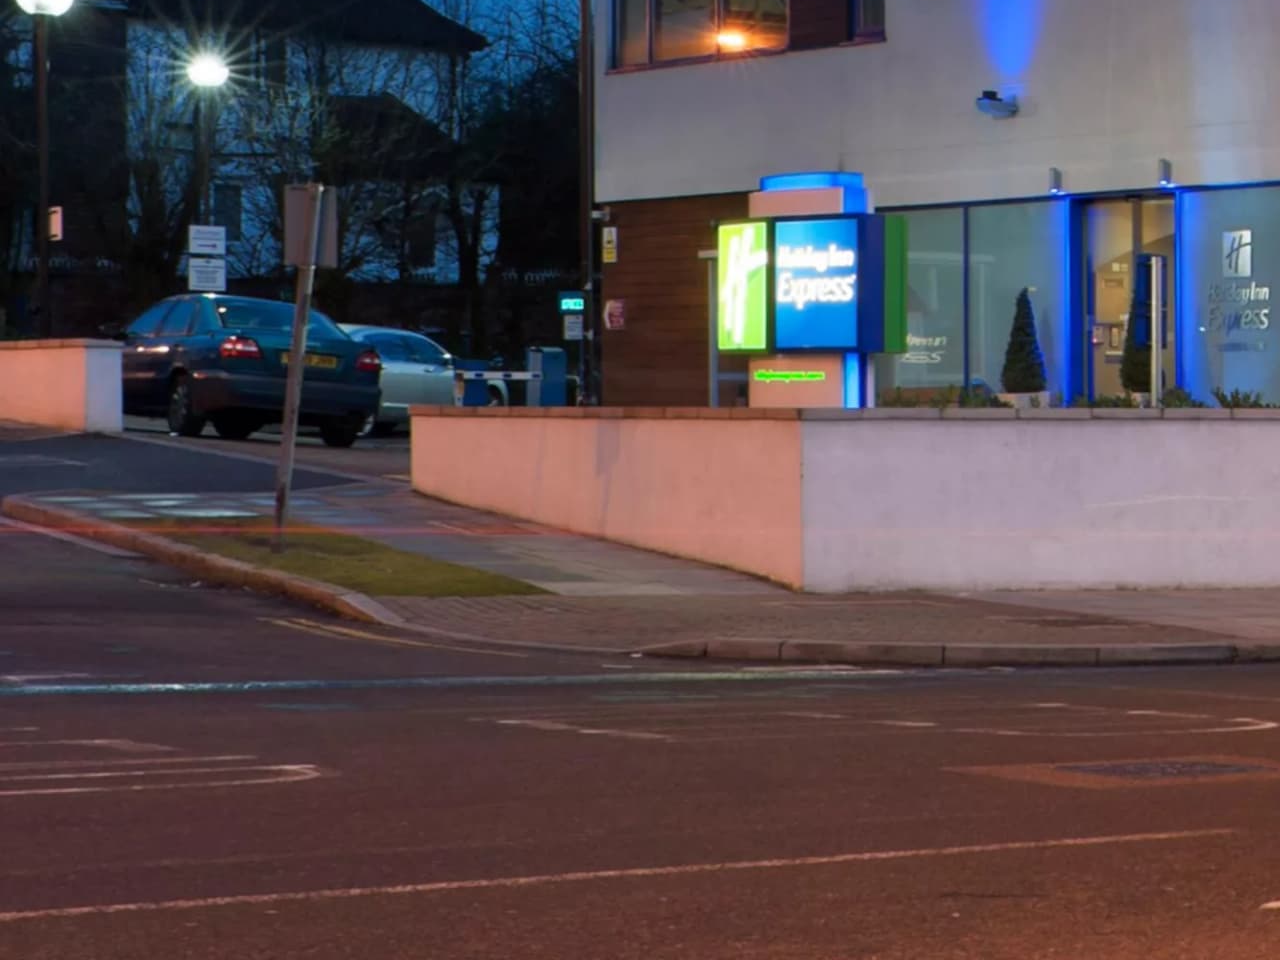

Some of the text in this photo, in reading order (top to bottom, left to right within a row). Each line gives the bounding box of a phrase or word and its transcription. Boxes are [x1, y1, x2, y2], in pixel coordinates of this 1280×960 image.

[777, 273, 857, 311] Express
[1250, 281, 1270, 301] Inn
[1208, 305, 1270, 337] Express
